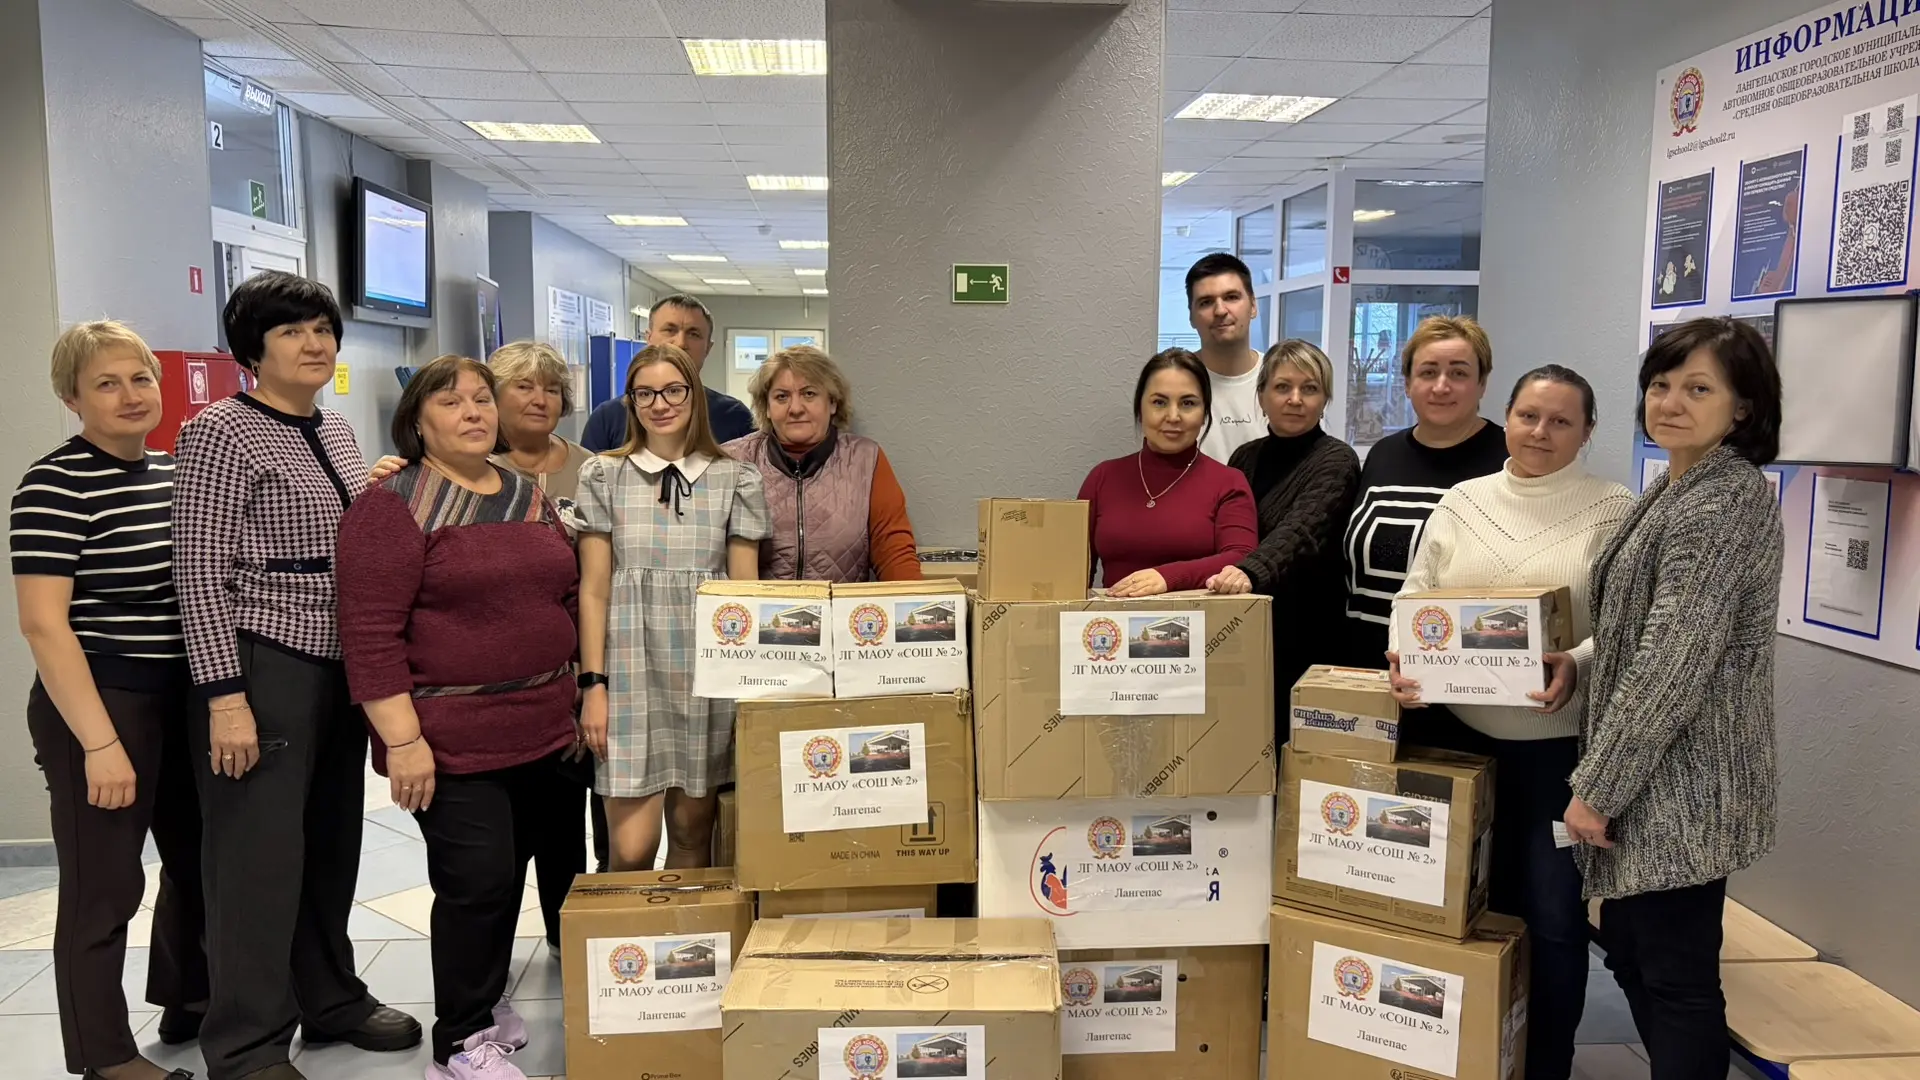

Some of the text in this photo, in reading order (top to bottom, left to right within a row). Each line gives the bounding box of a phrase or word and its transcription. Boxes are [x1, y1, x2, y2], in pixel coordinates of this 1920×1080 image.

[1736, 66, 1798, 93] ЛАНГЕПАССКОЕ
[1799, 48, 1851, 73] ГОРОДСКОЕ
[1722, 86, 1776, 111] АВТОНОМНОЕ
[1776, 51, 1888, 93] ОБЩЕОБРАЗОВАТЕЛЬНОЕ
[1771, 68, 1881, 110] ОБЩЕОБРАЗОВАТЕЛЬНАЯ
[1883, 56, 1920, 77] ШКОЛА
[245, 85, 271, 108] ВЫХОД
[213, 124, 221, 148] 2
[701, 648, 827, 662] ЛГ МАОУ «СОШ № 2»
[839, 647, 963, 660] ЛГ МАОУ «СОШ № 2»
[1403, 654, 1538, 668] ЛГ МАОУ «СОШ № 2»
[1072, 664, 1197, 675] ЛГ МАОУ «СОШ № 2»
[738, 675, 788, 686] Лангепас
[877, 675, 926, 685] Лангепас
[1444, 683, 1497, 694] Лангепас
[1110, 691, 1159, 701] Лангепас
[793, 775, 918, 793] ЛГ МАОУ «СОШ № 2»
[833, 806, 882, 817] Лангепас
[830, 850, 880, 860] MADE IN CHINA
[896, 849, 915, 857] THIS
[1309, 833, 1437, 865] ЛГ МАОУ «СОШ № 2»
[1077, 860, 1198, 873] ЛГ МАОУ «СОШ № 2»
[1346, 865, 1396, 884] Лангепас
[1114, 888, 1162, 898] Лангепас
[599, 982, 723, 998] ЛГ МАОУ «СОШ № 2»
[637, 1010, 686, 1021] Лангепас
[1067, 1006, 1168, 1018] МАОУ «СОШ № 2»
[1321, 994, 1450, 1036] ЛГ МАОУ «СОШ № 2»
[1085, 1032, 1132, 1042] Лангепас
[1356, 1030, 1408, 1051] Лангепас
